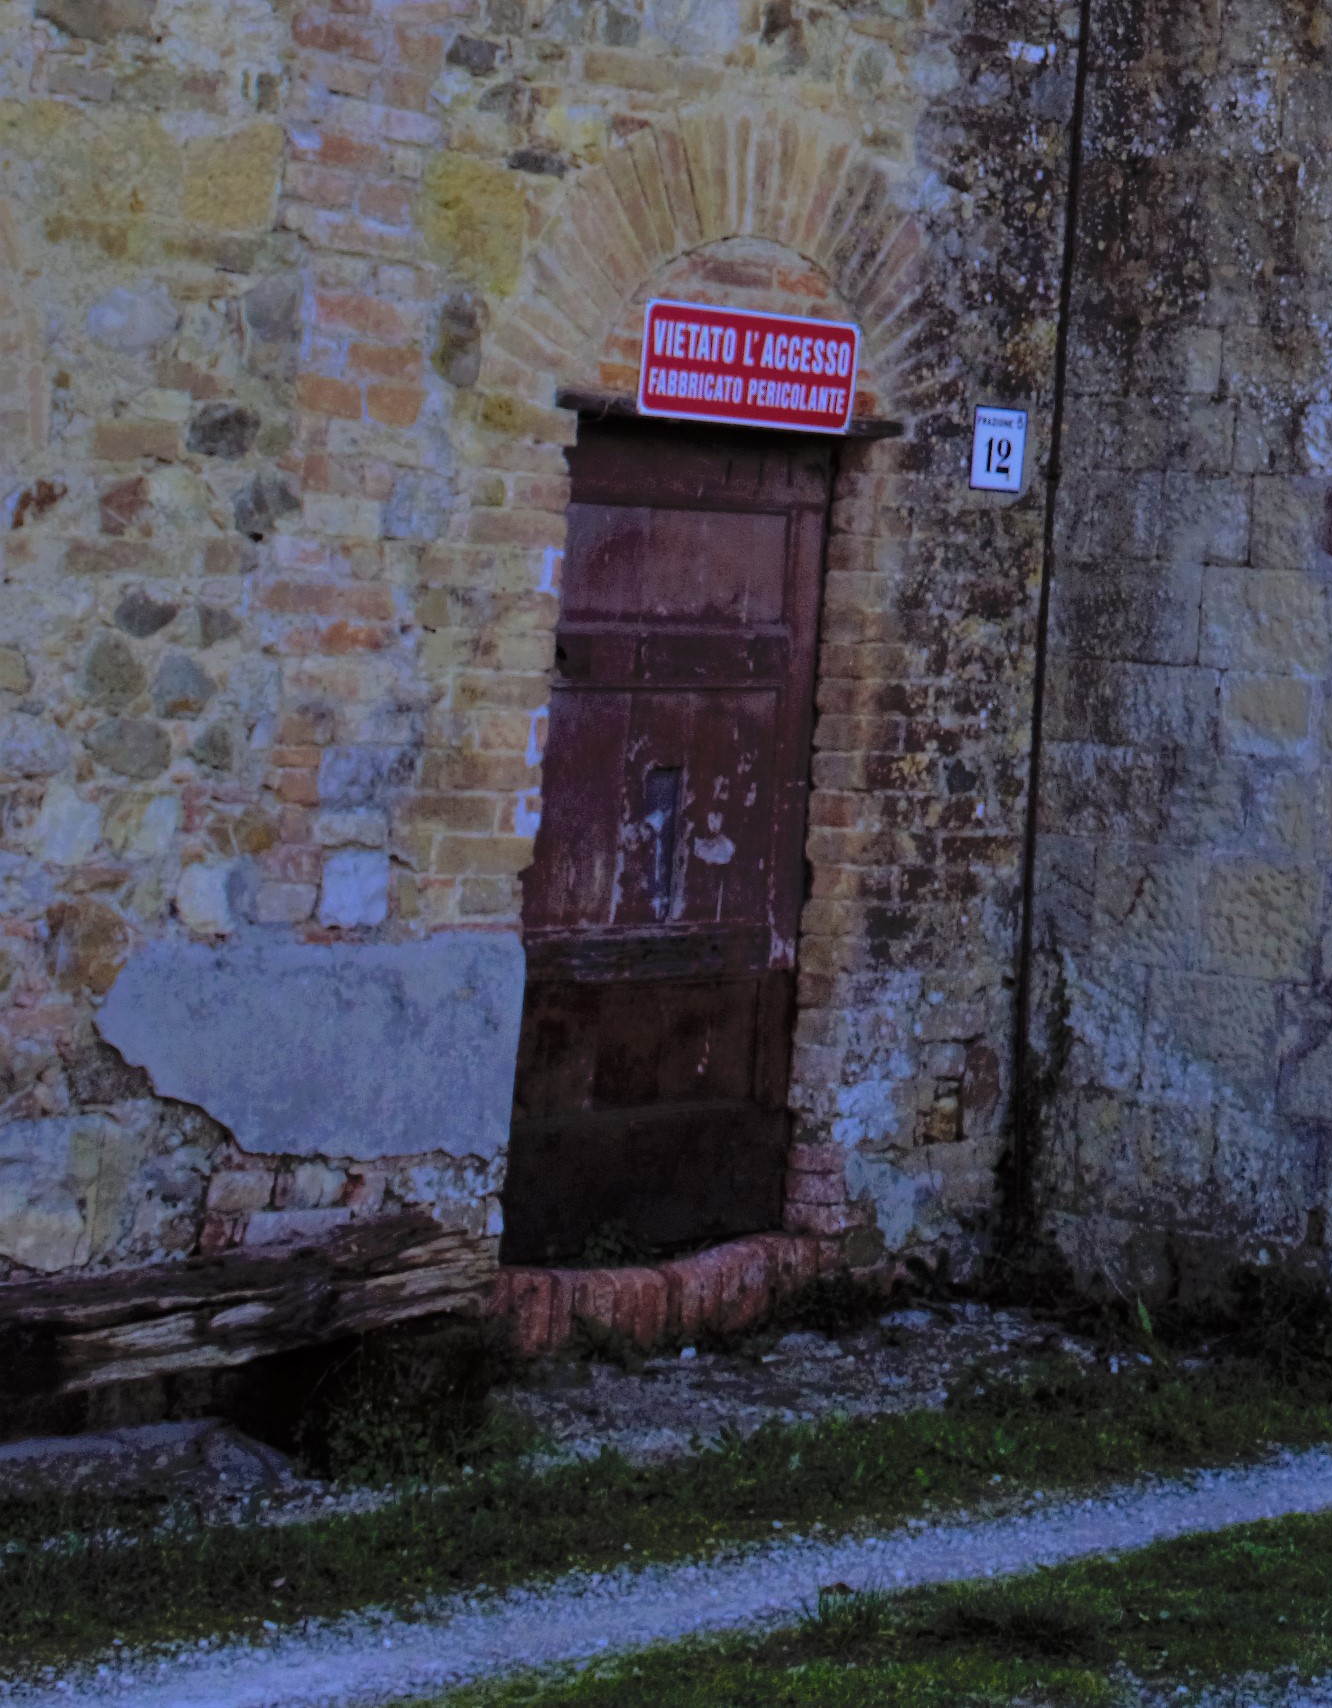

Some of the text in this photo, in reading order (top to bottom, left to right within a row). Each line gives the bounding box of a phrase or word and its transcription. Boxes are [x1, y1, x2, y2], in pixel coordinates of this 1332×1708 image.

[654, 319, 738, 364] VIETATO
[648, 366, 846, 415] FABBRICATO PERICOLANTE
[986, 437, 1012, 473] 12
